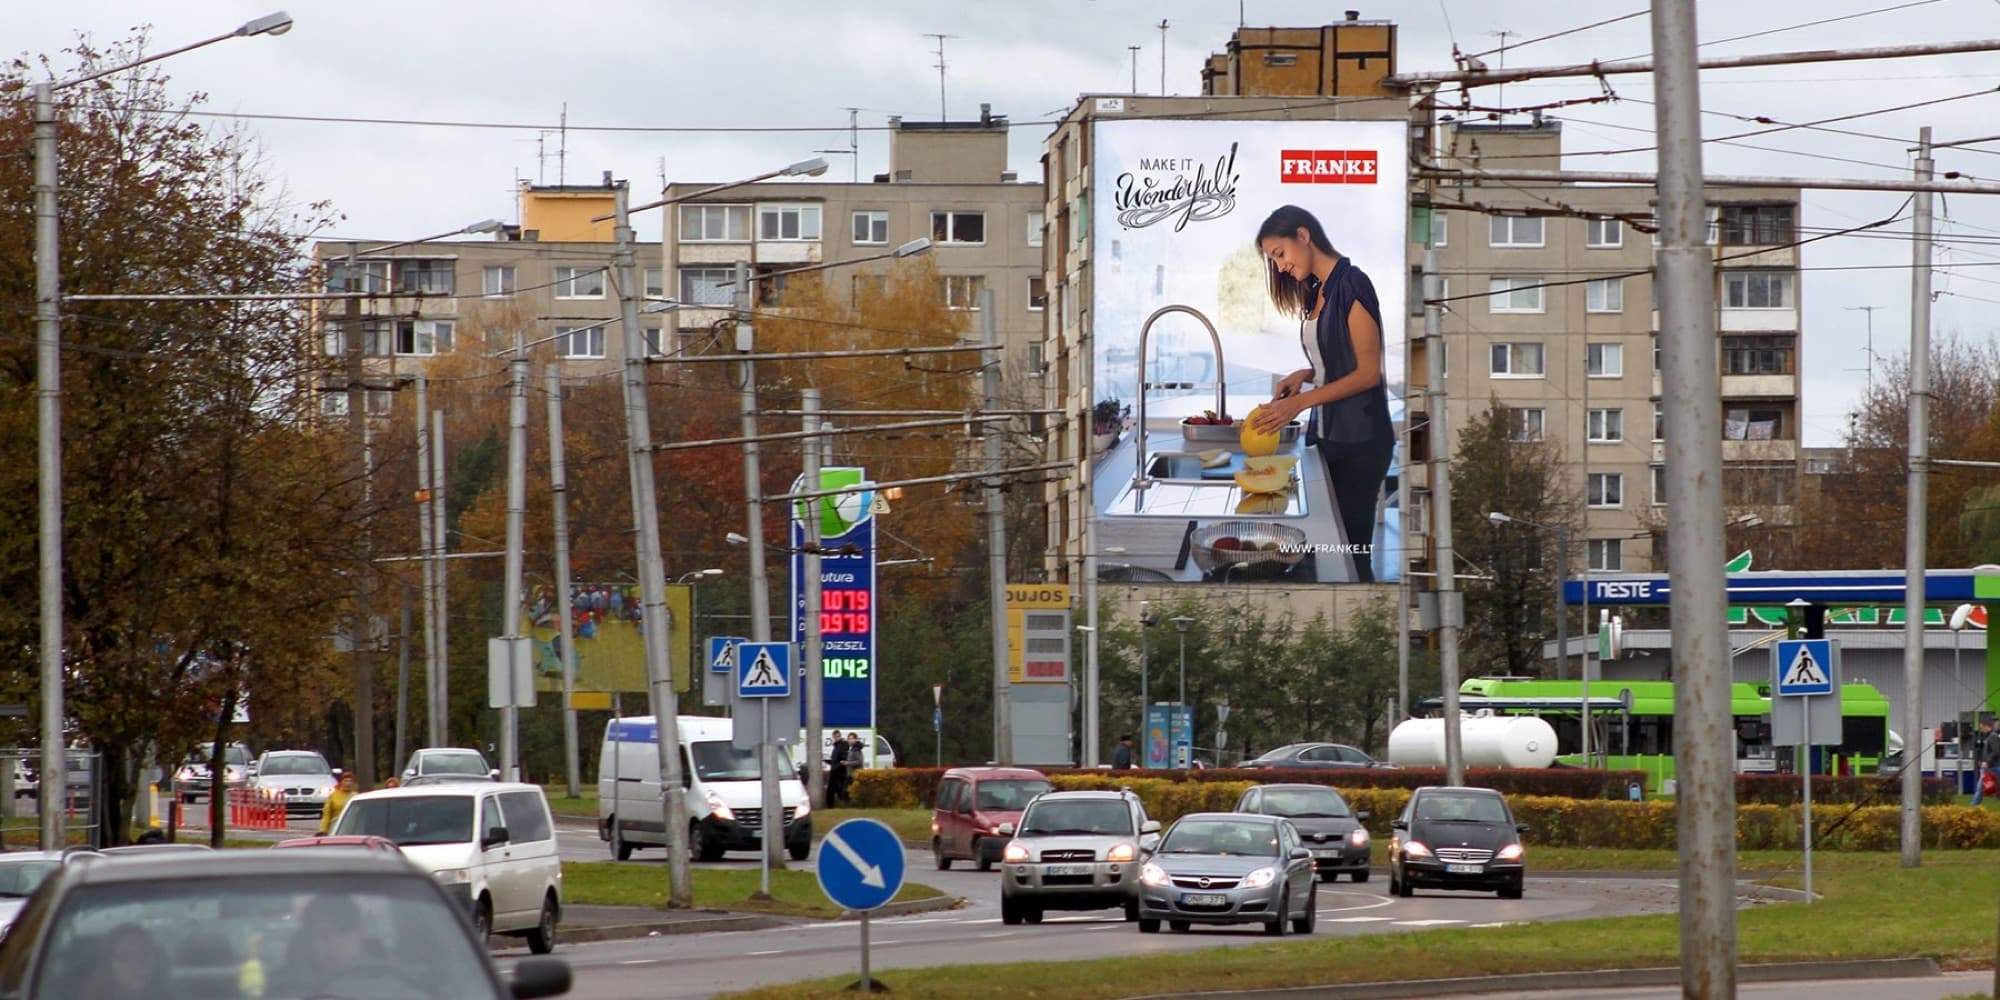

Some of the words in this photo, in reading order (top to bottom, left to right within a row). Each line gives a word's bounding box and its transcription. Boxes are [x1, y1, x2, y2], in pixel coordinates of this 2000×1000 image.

[1140, 158, 1177, 171] MAKE
[1181, 158, 1193, 171] IT
[1282, 159, 1376, 175] FRANKE
[1279, 543, 1375, 555] WWW.FRANKE.LT
[820, 572, 855, 583] utura
[1597, 581, 1652, 599] NESTE
[825, 641, 867, 651] DIESEL
